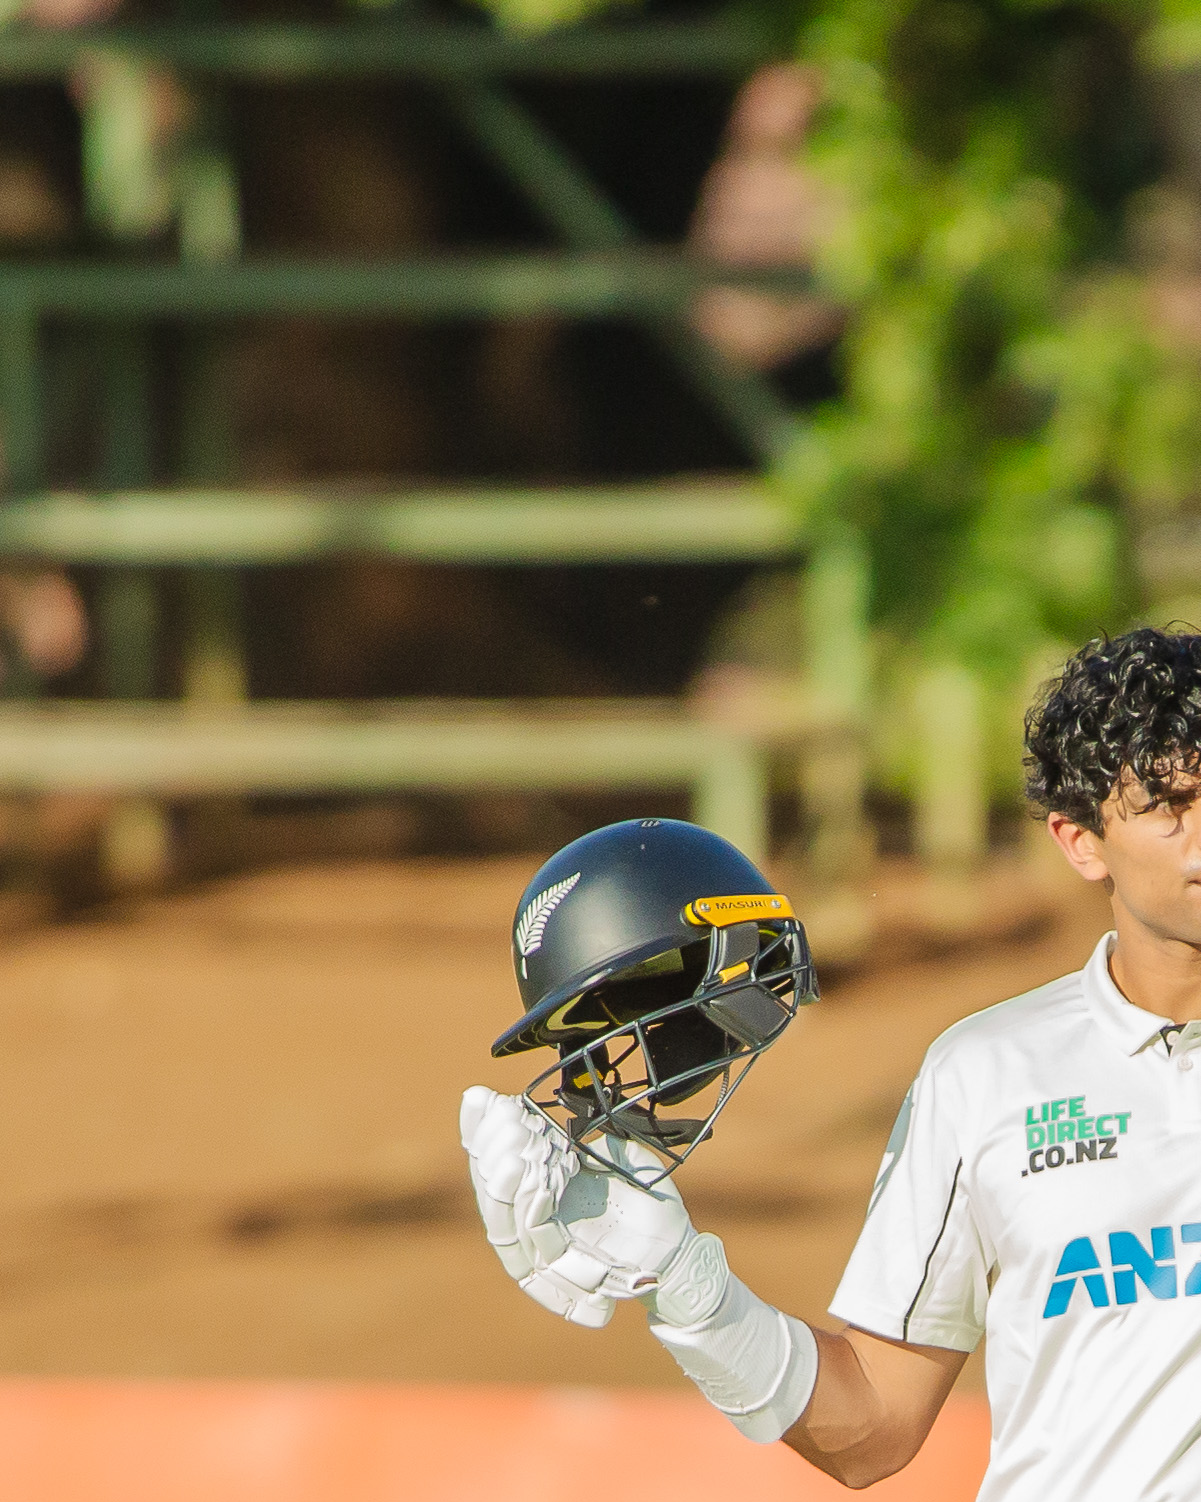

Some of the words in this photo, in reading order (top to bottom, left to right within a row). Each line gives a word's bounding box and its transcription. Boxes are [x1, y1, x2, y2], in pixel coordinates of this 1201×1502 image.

[715, 899, 768, 910] MASURI
[1025, 1095, 1086, 1126] LIFE
[1025, 1112, 1132, 1150] DIRECT
[1021, 1136, 1118, 1177] .CO.NZ
